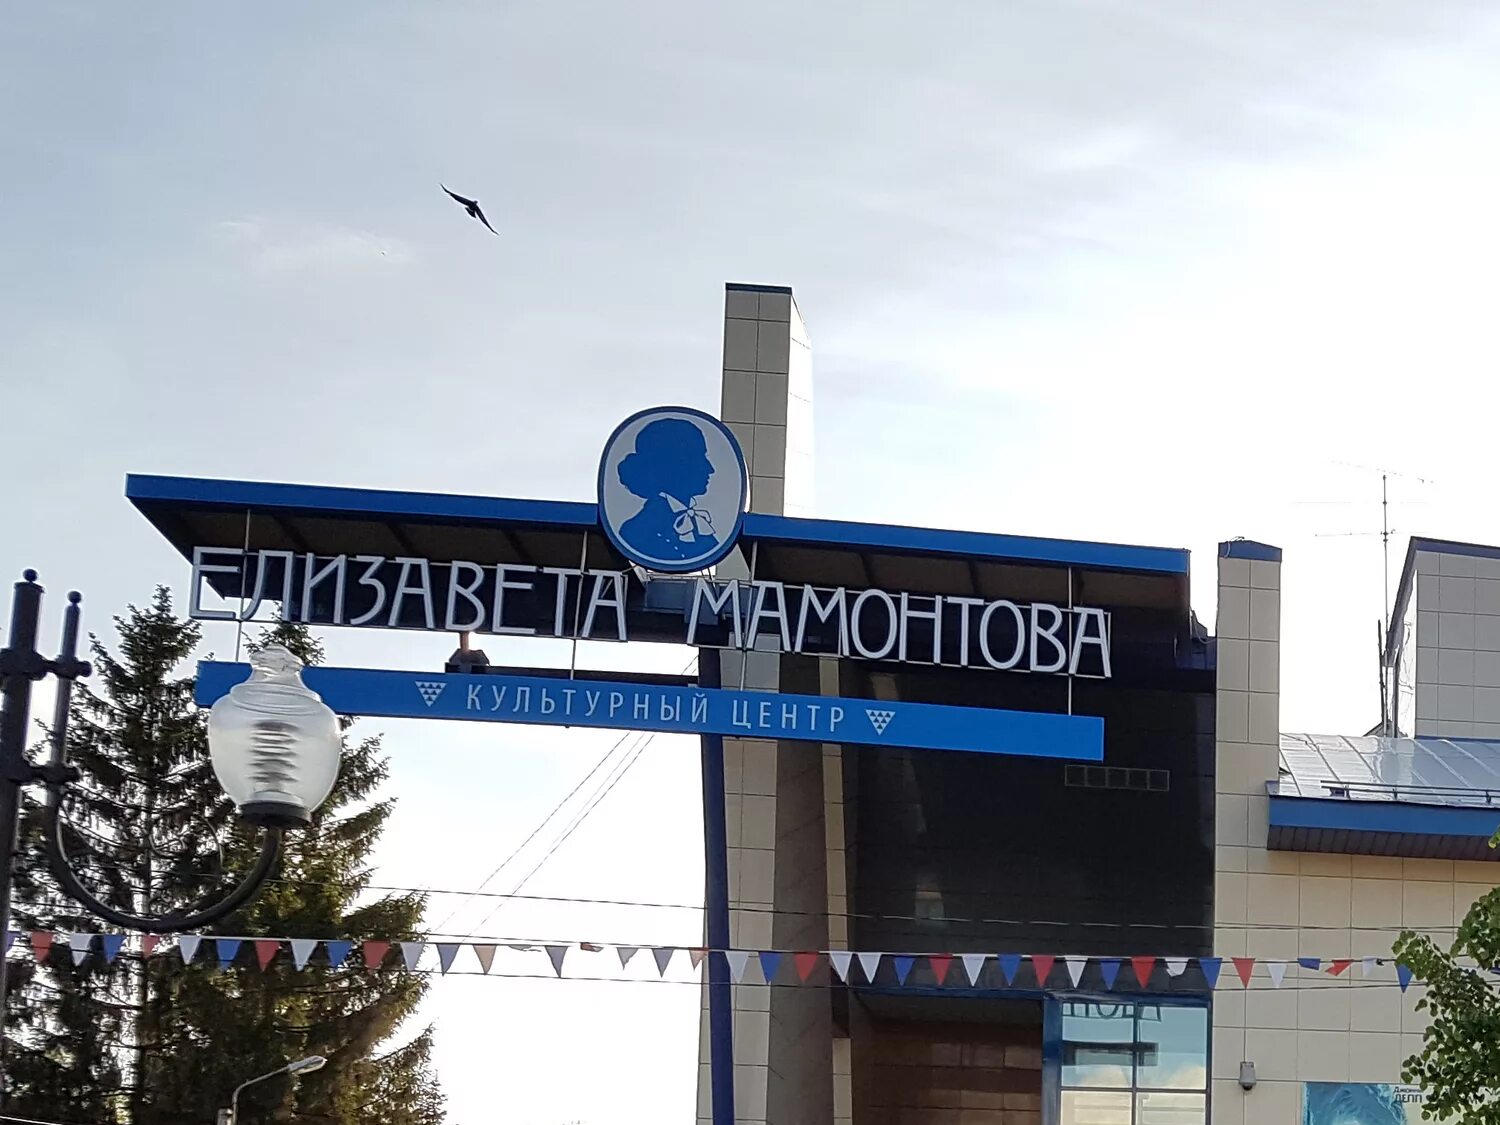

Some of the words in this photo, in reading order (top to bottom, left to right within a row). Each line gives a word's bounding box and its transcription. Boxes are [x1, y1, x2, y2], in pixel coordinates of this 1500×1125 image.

[189, 546, 628, 642] ЕЛИЗАВЕТА
[687, 578, 1112, 678] МАМОНТОВА
[467, 684, 708, 724] КУЛЬТУРНЫЙ
[732, 699, 845, 732] ЦЕНТР
